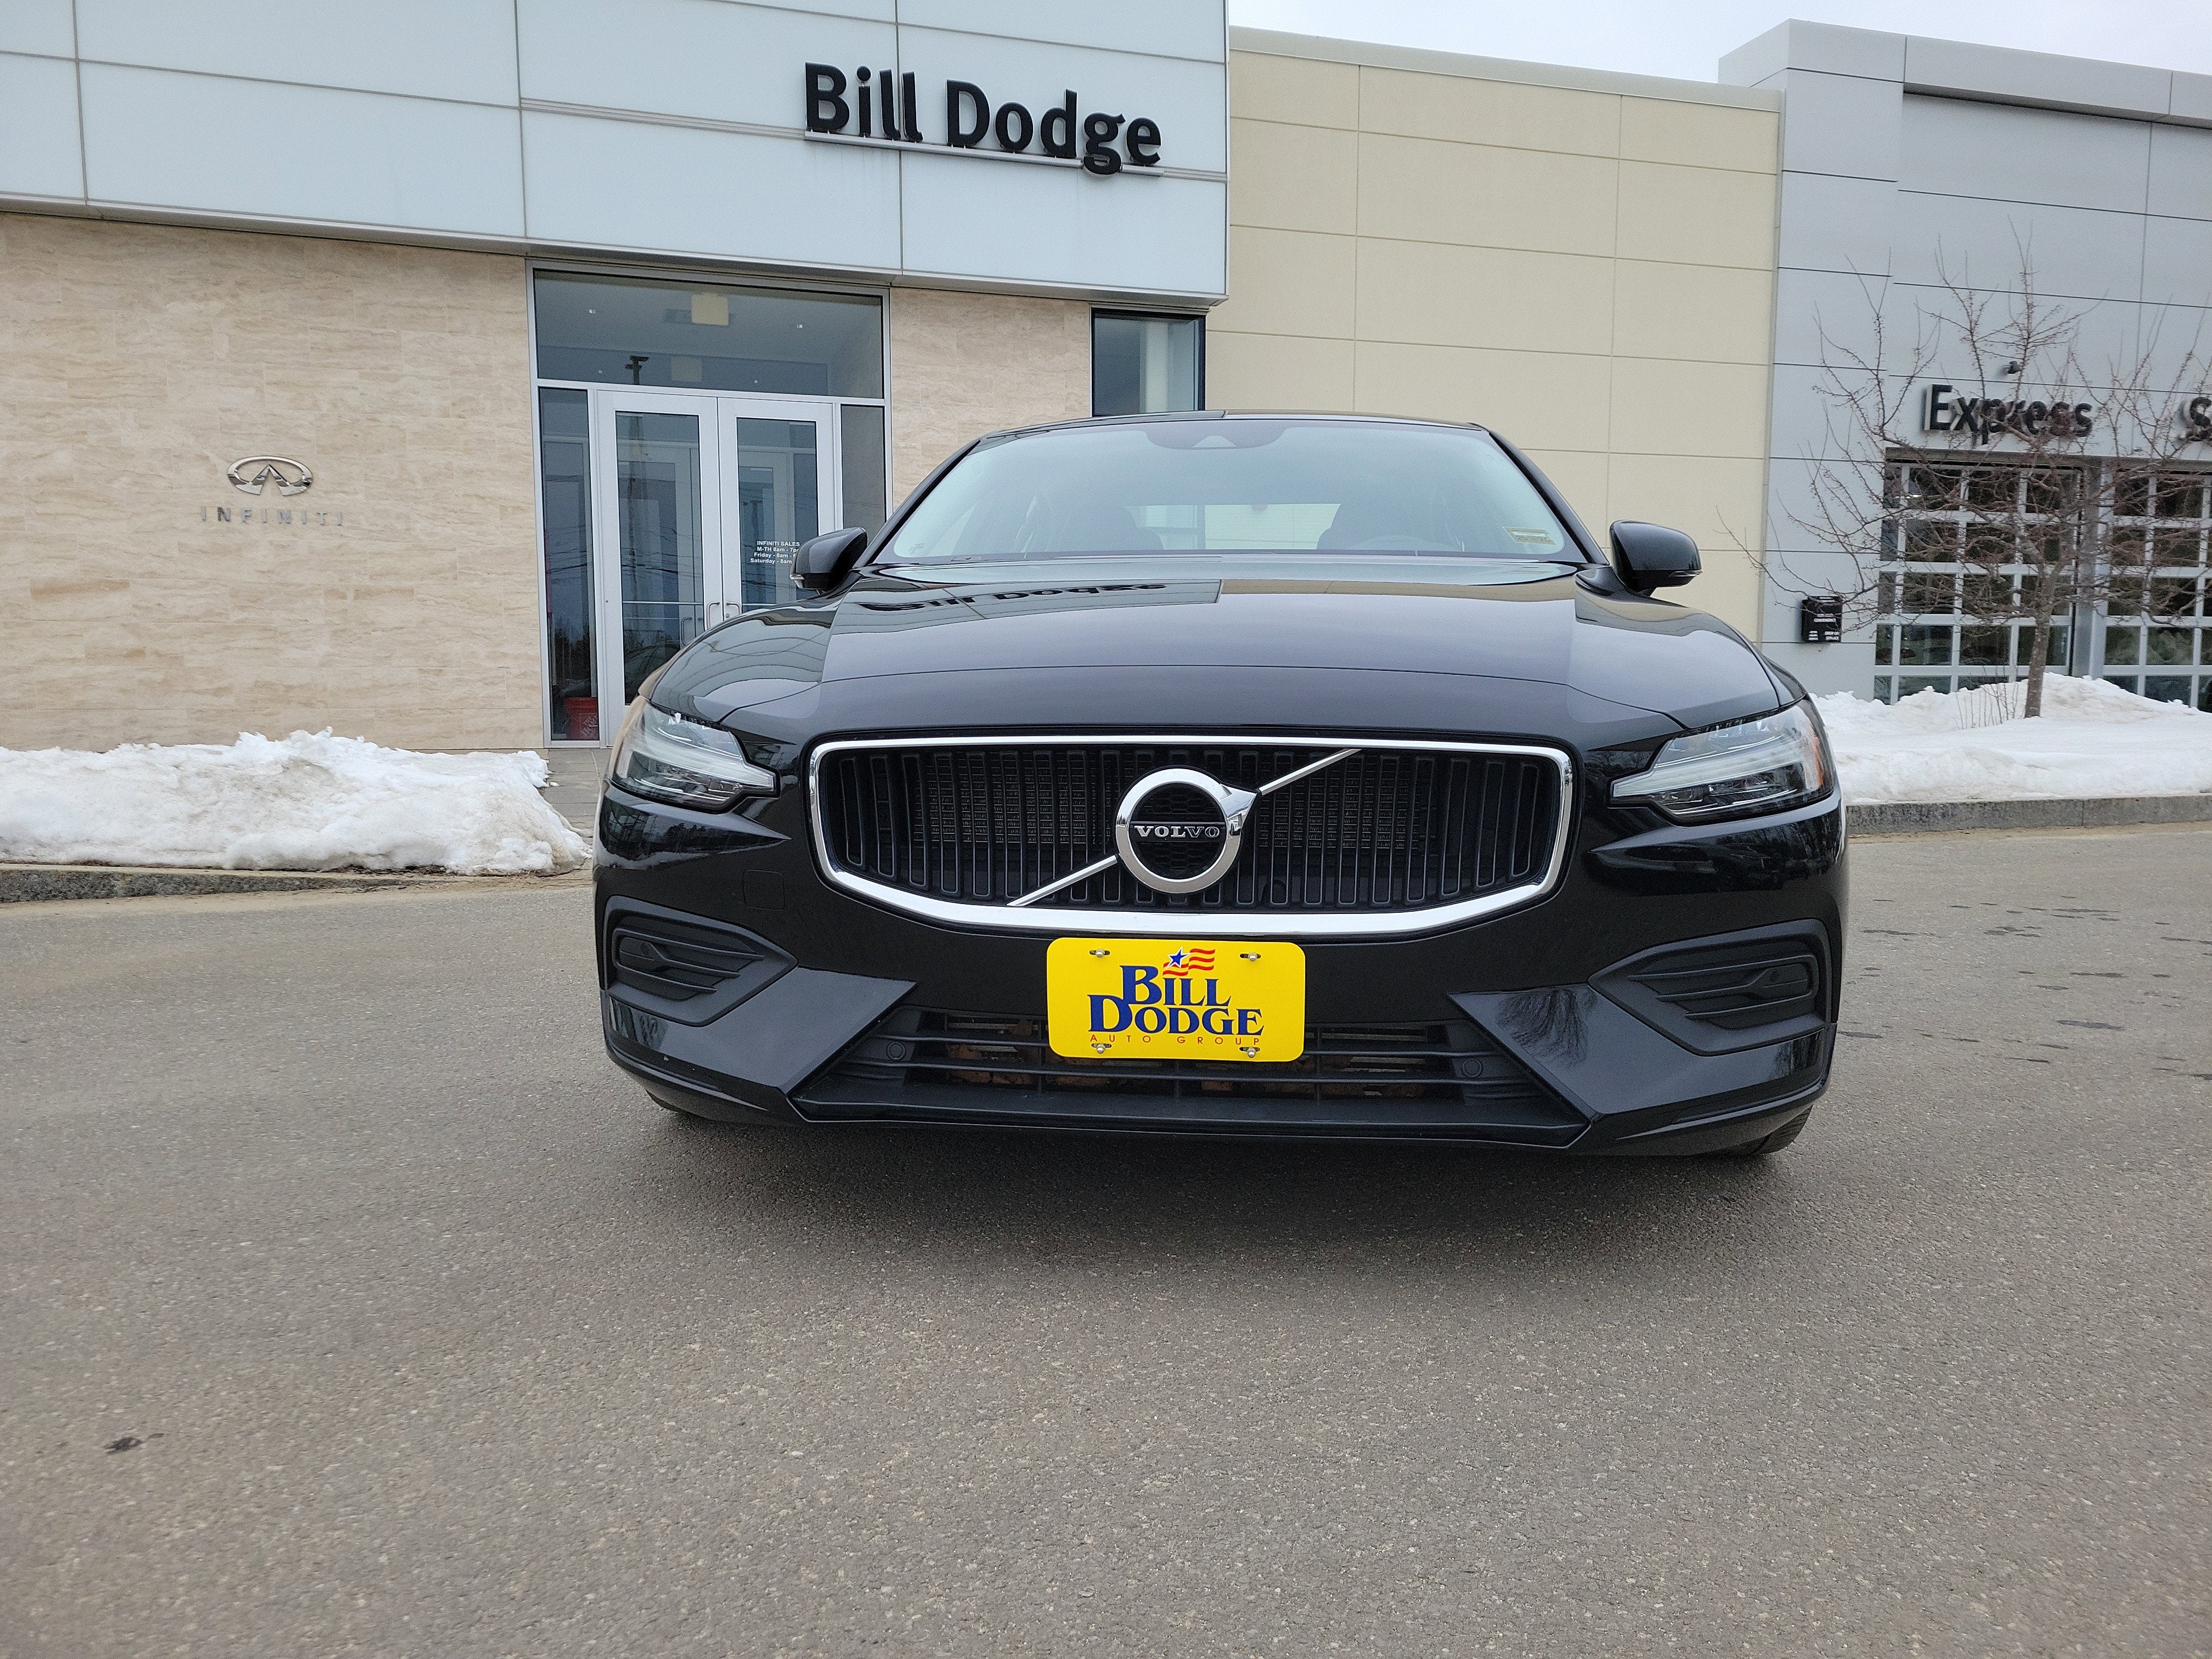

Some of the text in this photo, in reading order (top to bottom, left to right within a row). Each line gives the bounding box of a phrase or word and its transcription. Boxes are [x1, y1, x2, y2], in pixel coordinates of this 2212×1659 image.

[805, 62, 1162, 176] Bill Dodge
[200, 506, 343, 526] INFINITI
[1134, 825, 1220, 838] VOLVO
[1120, 965, 1232, 1006] BILL
[1087, 994, 1265, 1036] DODGE
[1090, 1034, 1260, 1046] AUTO GROUP
